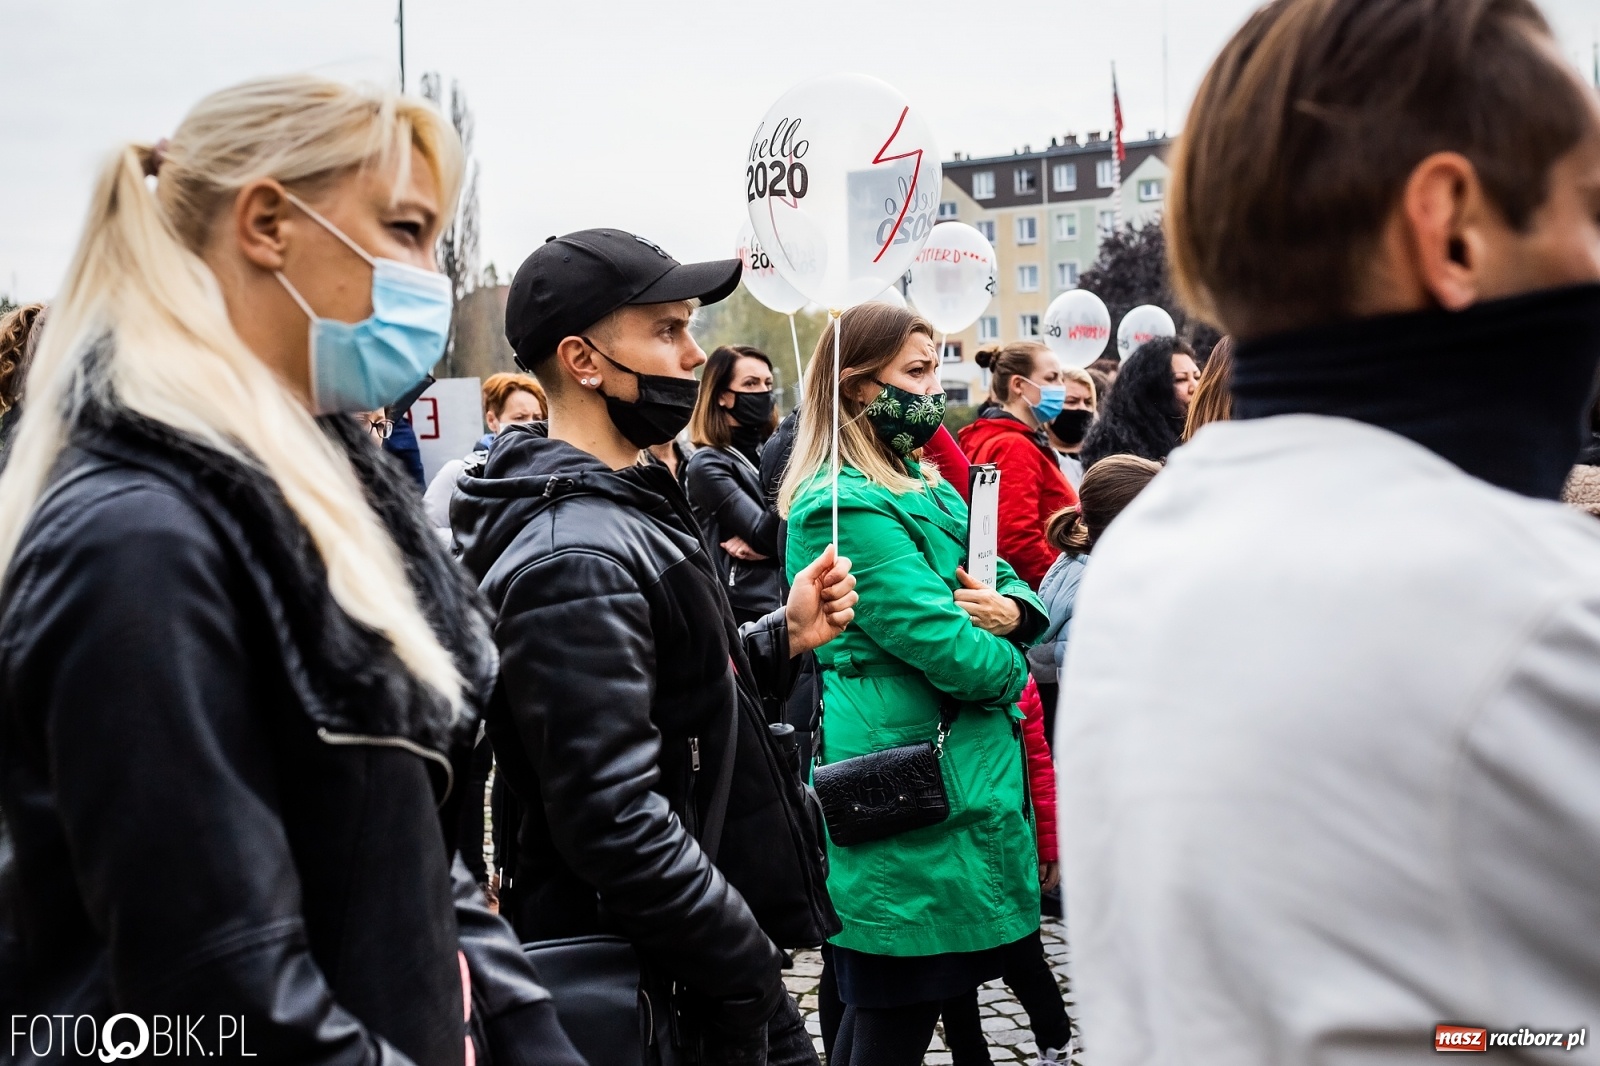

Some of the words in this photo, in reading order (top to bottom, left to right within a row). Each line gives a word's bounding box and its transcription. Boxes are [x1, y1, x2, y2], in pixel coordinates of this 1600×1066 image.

[748, 117, 809, 162] hello
[746, 160, 809, 203] 2020
[751, 252, 775, 270] 20
